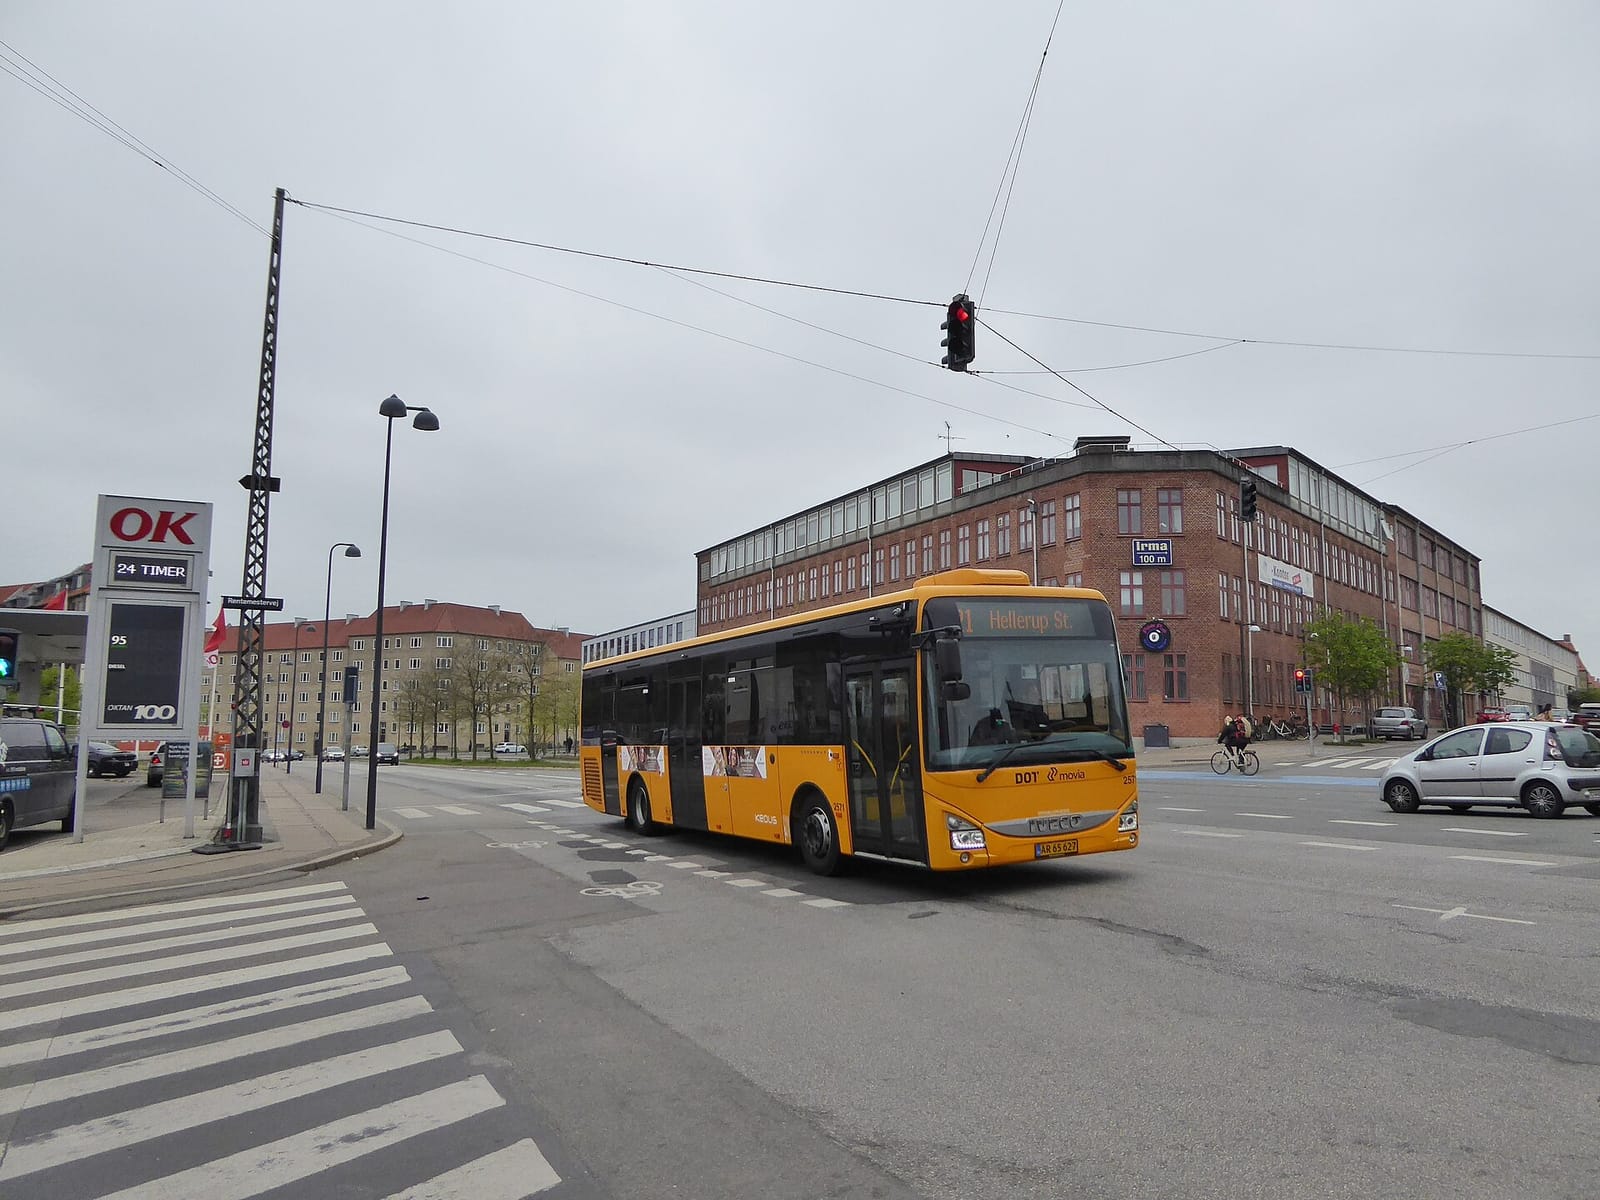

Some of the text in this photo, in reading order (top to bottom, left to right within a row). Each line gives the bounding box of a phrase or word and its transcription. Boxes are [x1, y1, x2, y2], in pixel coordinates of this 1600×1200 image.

[110, 507, 198, 545] OK
[1136, 541, 1168, 551] Irma
[1139, 555, 1155, 563] 100
[117, 563, 186, 577] 24 TIMER
[989, 610, 1049, 633] Hellerup
[1054, 610, 1073, 630] St.
[111, 635, 127, 645] 95
[1435, 672, 1442, 681] P
[133, 704, 176, 720] 100
[1015, 771, 1040, 784] DOT
[1059, 770, 1085, 780] movia
[1028, 816, 1081, 832] IVECO
[1040, 842, 1076, 854] AR 65 627
